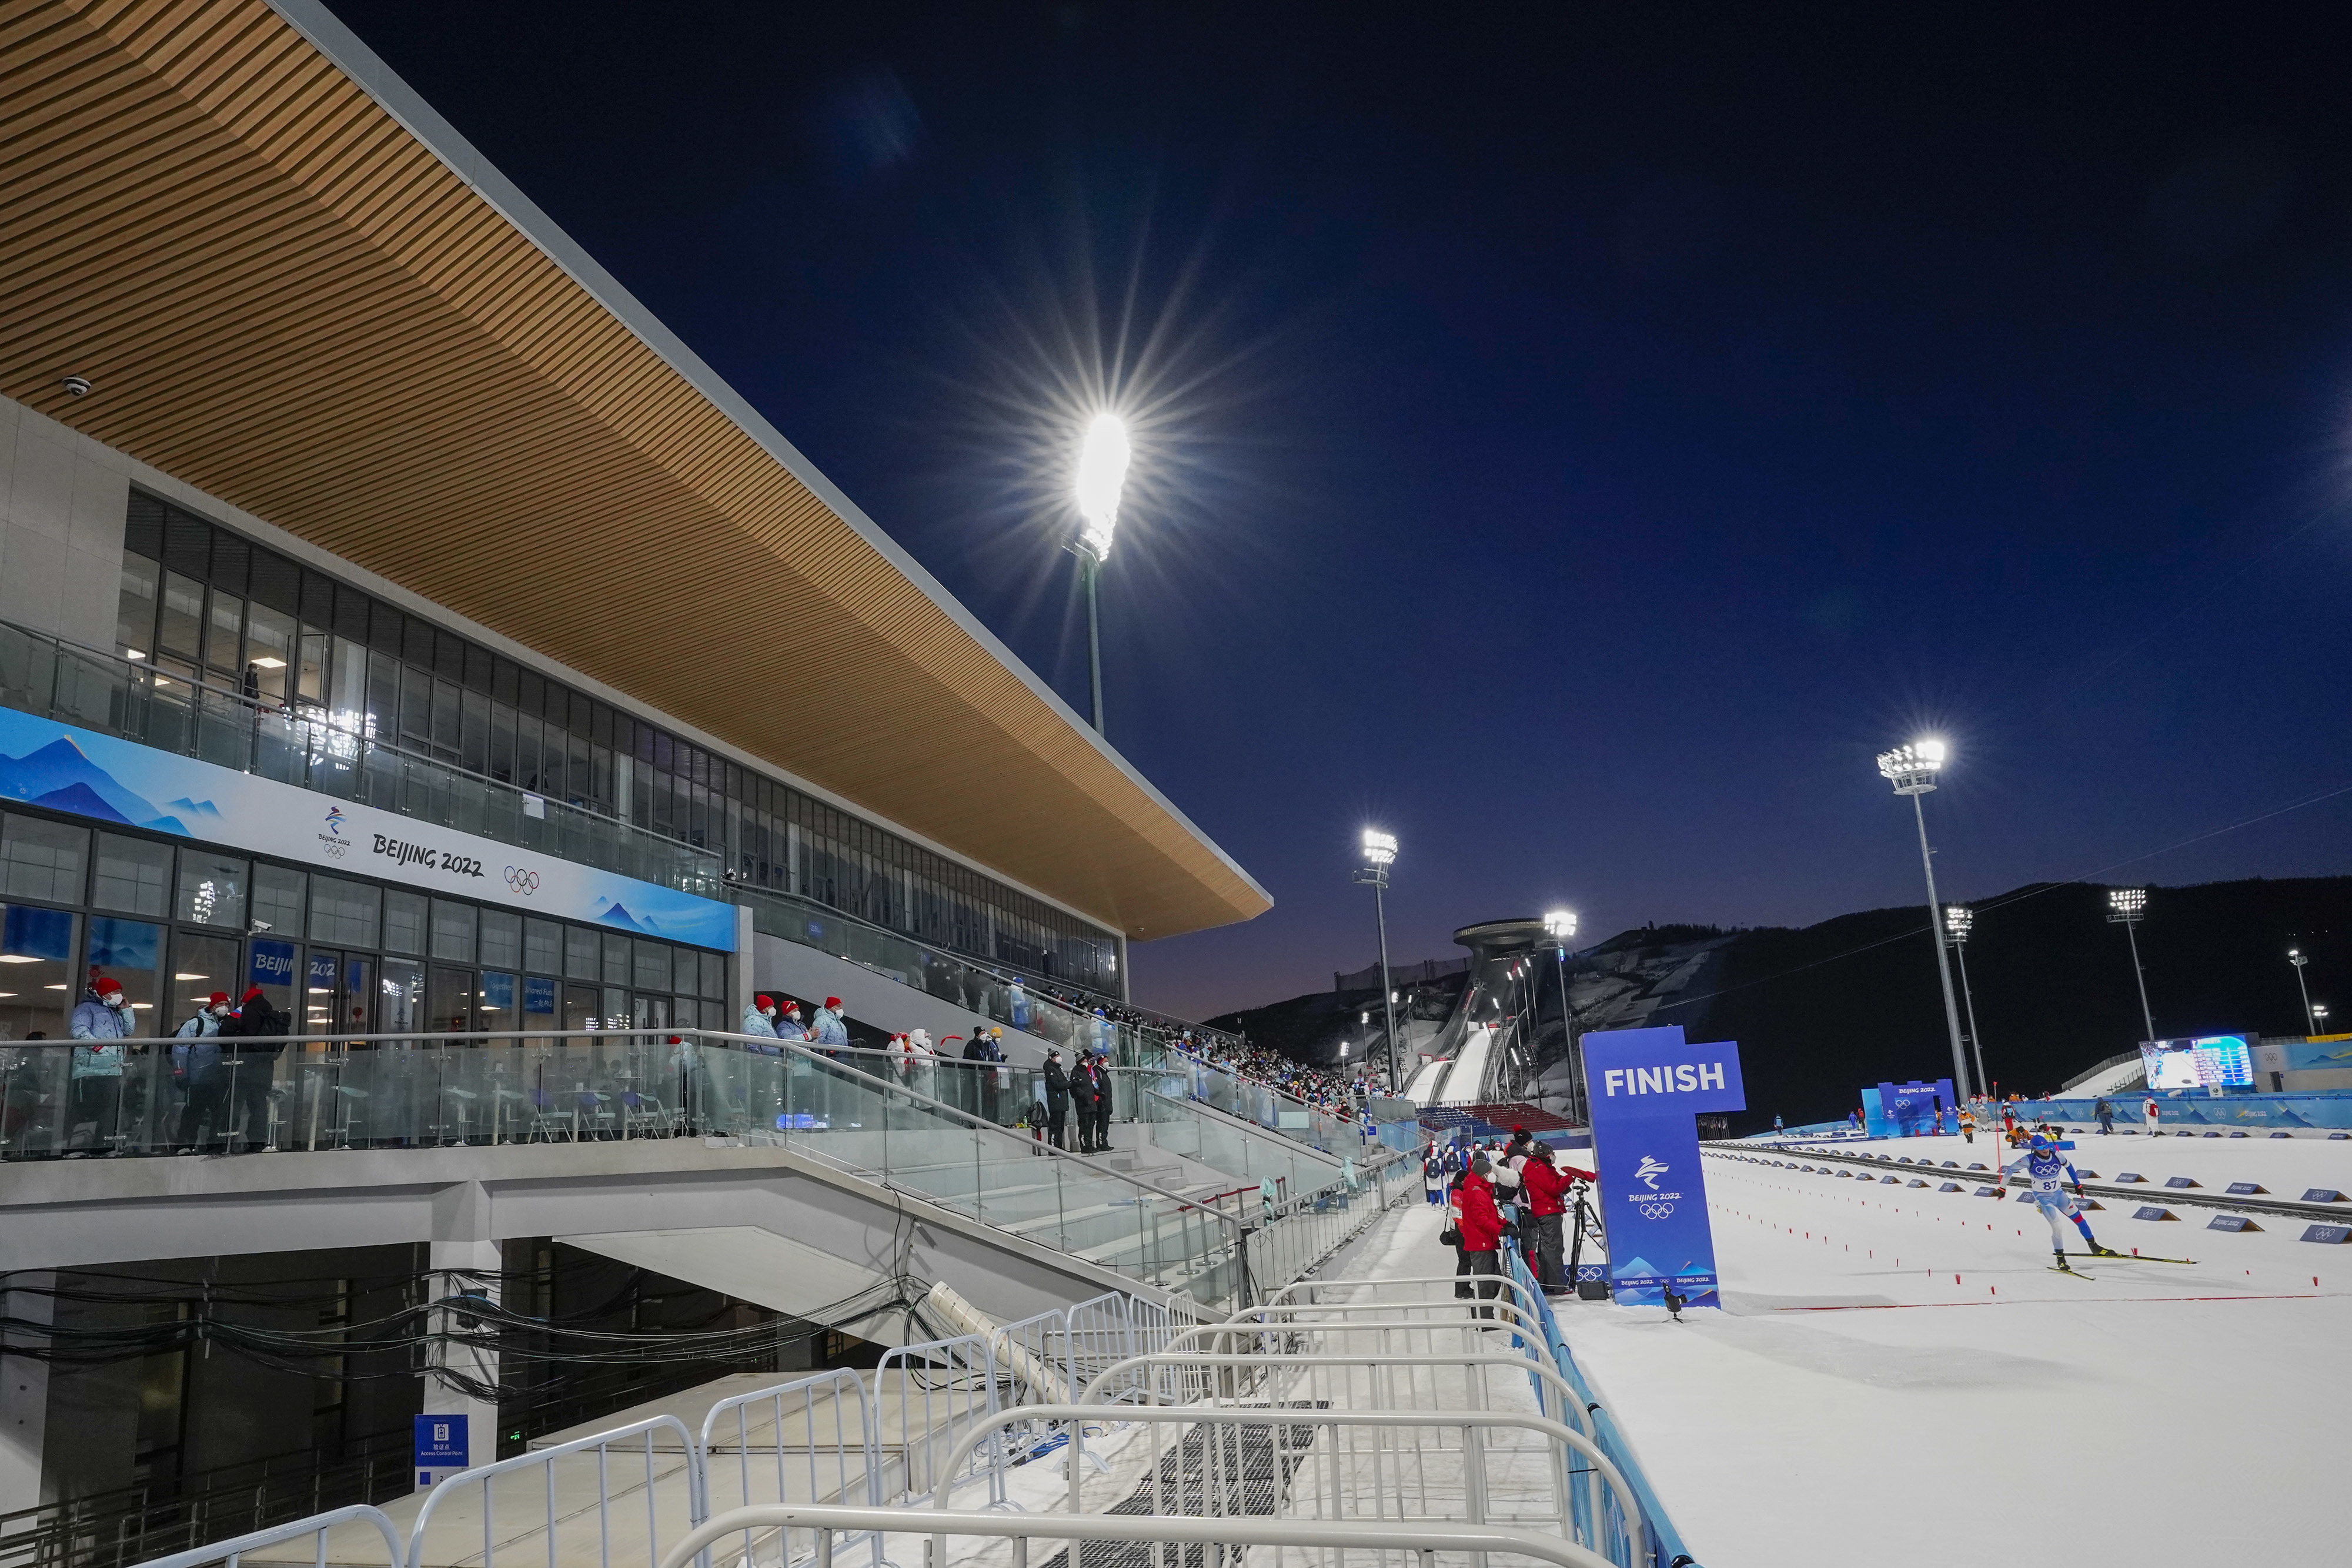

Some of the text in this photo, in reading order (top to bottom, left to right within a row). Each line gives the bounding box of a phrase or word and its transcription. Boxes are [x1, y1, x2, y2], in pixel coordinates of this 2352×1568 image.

[318, 833, 336, 843] BEIJING
[373, 834, 485, 878] BEIJING 2022
[1605, 1062, 1725, 1096] FINISH
[2043, 1180, 2057, 1191] 87
[1628, 1193, 1658, 1203] BEIJING
